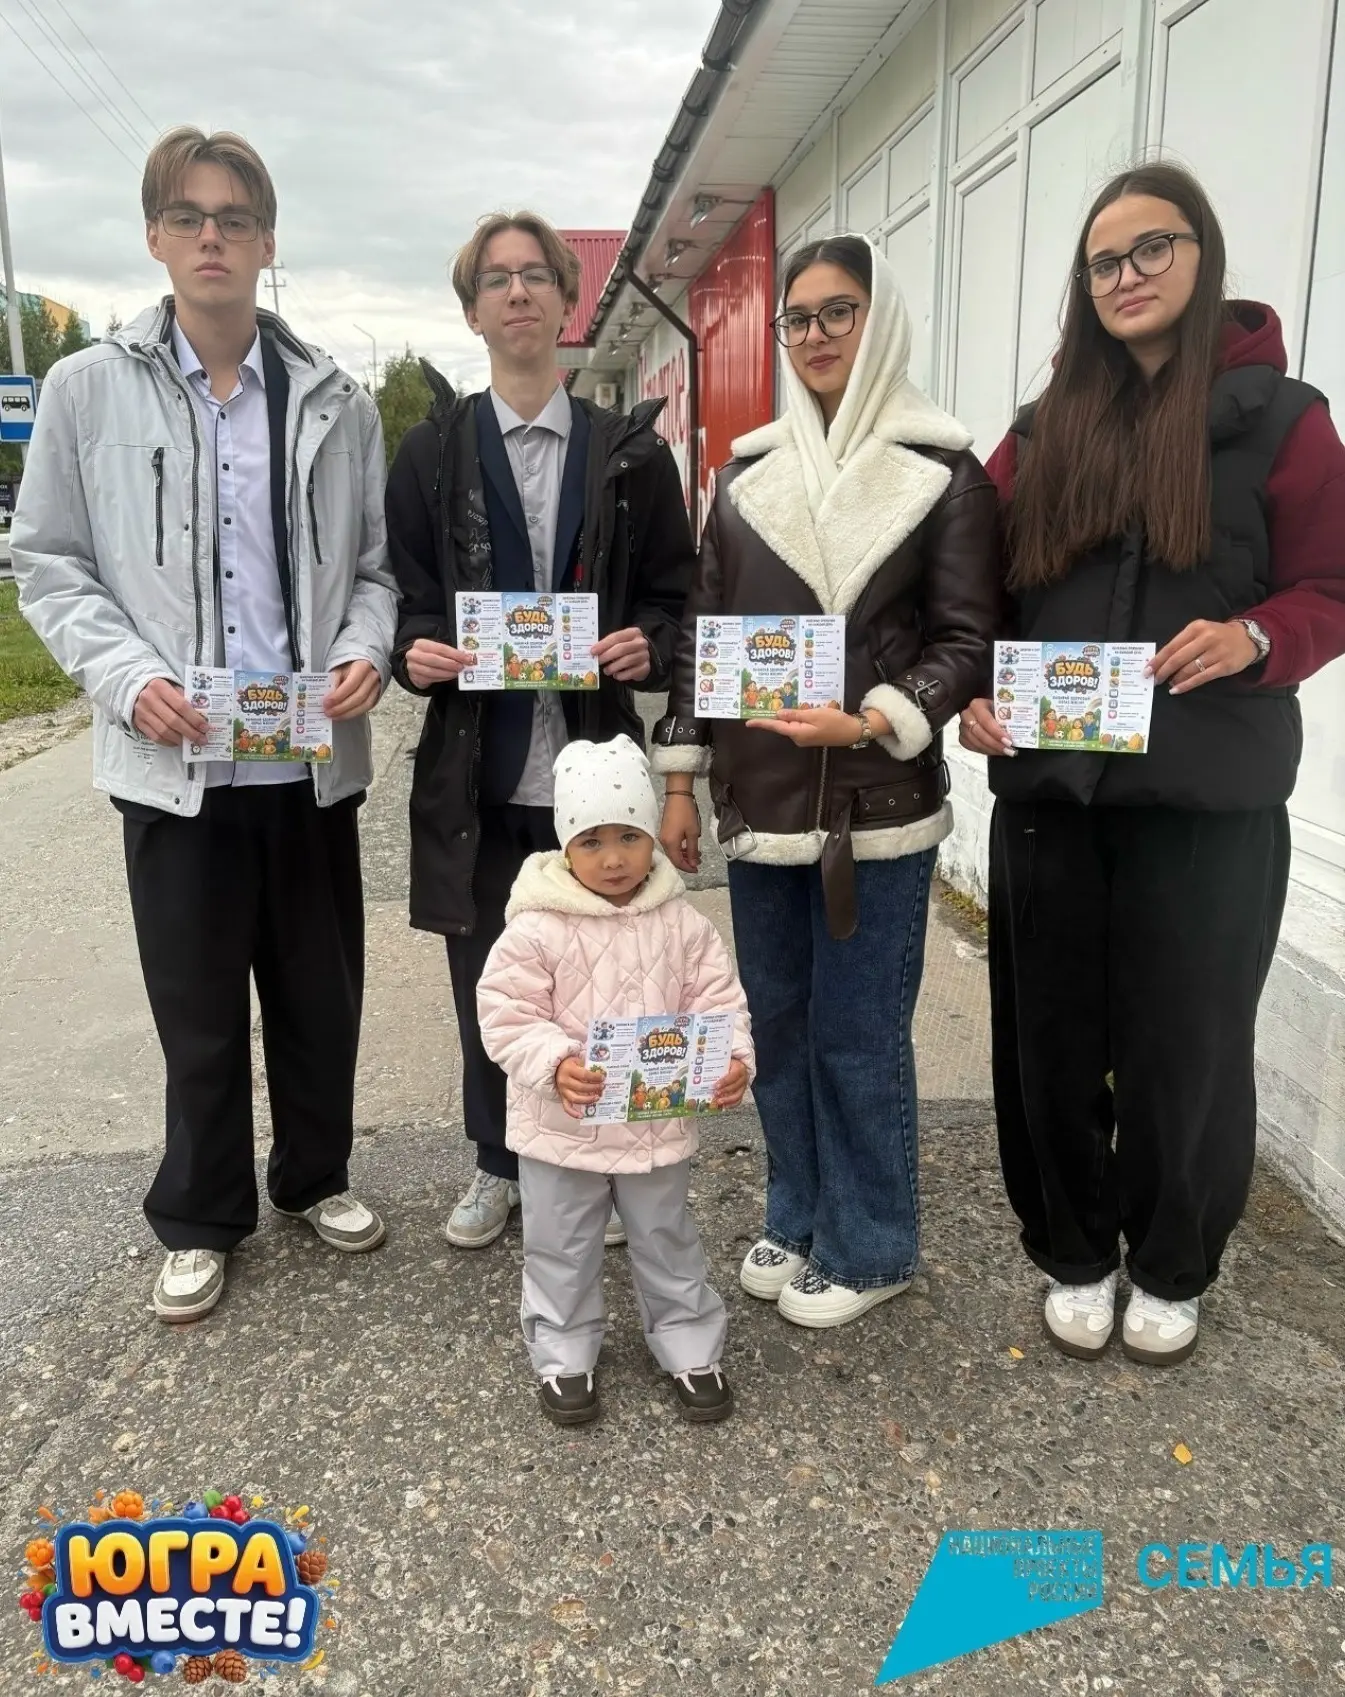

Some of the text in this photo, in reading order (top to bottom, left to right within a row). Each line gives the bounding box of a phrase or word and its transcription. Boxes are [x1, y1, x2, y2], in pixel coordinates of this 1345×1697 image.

[513, 611, 549, 624] БУДЬ
[510, 623, 553, 634] ЗДОРОВ!
[754, 635, 791, 648] БУДЬ
[749, 648, 795, 660] ЗДОРОВ!
[1054, 661, 1095, 676] БУДЬ
[1049, 675, 1099, 688] ЗДОРОВ!
[247, 688, 284, 700] БУДЬ
[242, 700, 288, 711] ЗДОРОВ!
[648, 1033, 683, 1047] БУДЬ
[642, 1046, 688, 1060] ЗДОРОВ!
